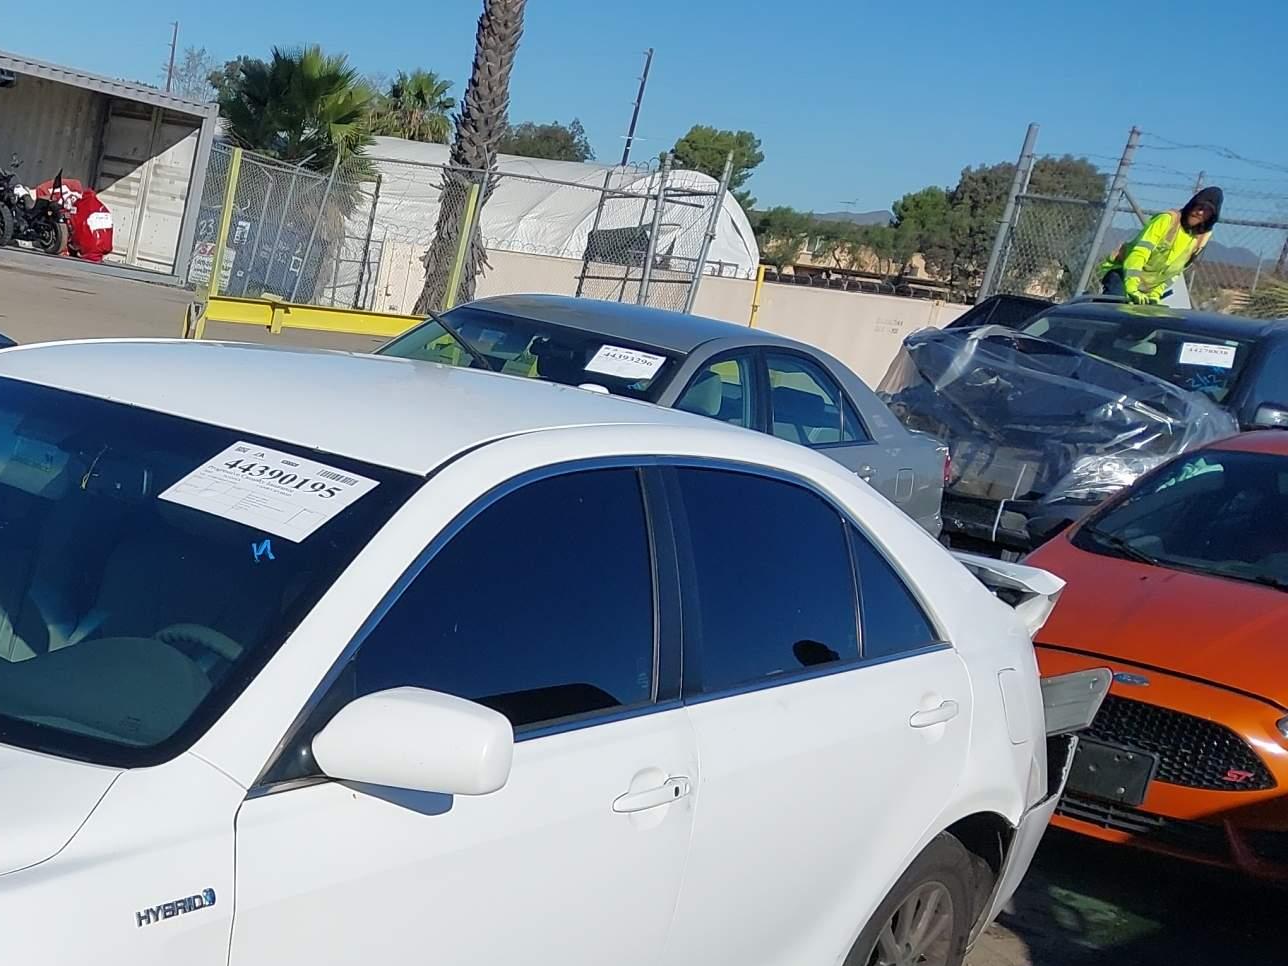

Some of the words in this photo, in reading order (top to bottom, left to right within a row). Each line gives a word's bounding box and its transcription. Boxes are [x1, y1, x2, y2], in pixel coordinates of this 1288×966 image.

[223, 458, 342, 499] 44390195
[1223, 768, 1254, 782] ST
[135, 894, 204, 927] HYBRID
